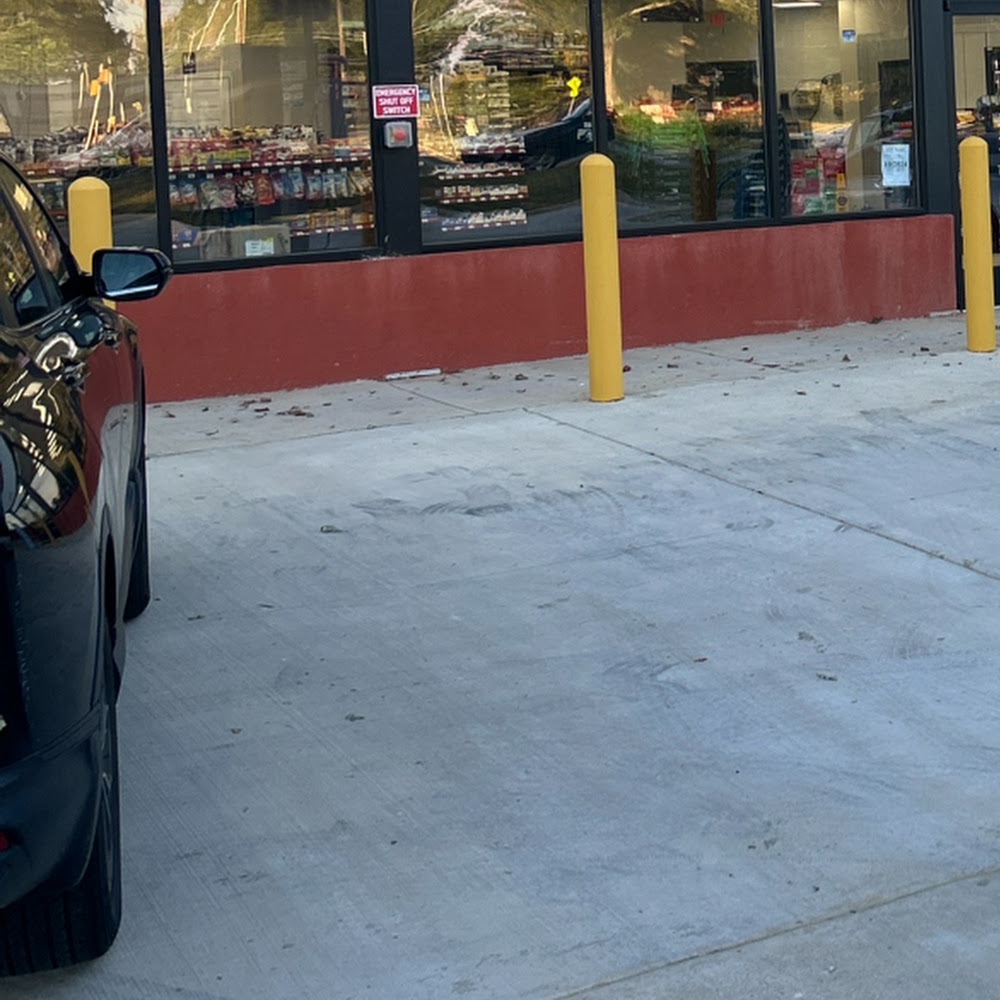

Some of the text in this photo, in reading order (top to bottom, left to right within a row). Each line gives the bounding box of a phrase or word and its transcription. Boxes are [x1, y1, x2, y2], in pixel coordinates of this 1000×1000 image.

[375, 88, 416, 97] EMERGENCY
[379, 97, 413, 105] SHUT OFF
[383, 106, 411, 114] SWITCH
